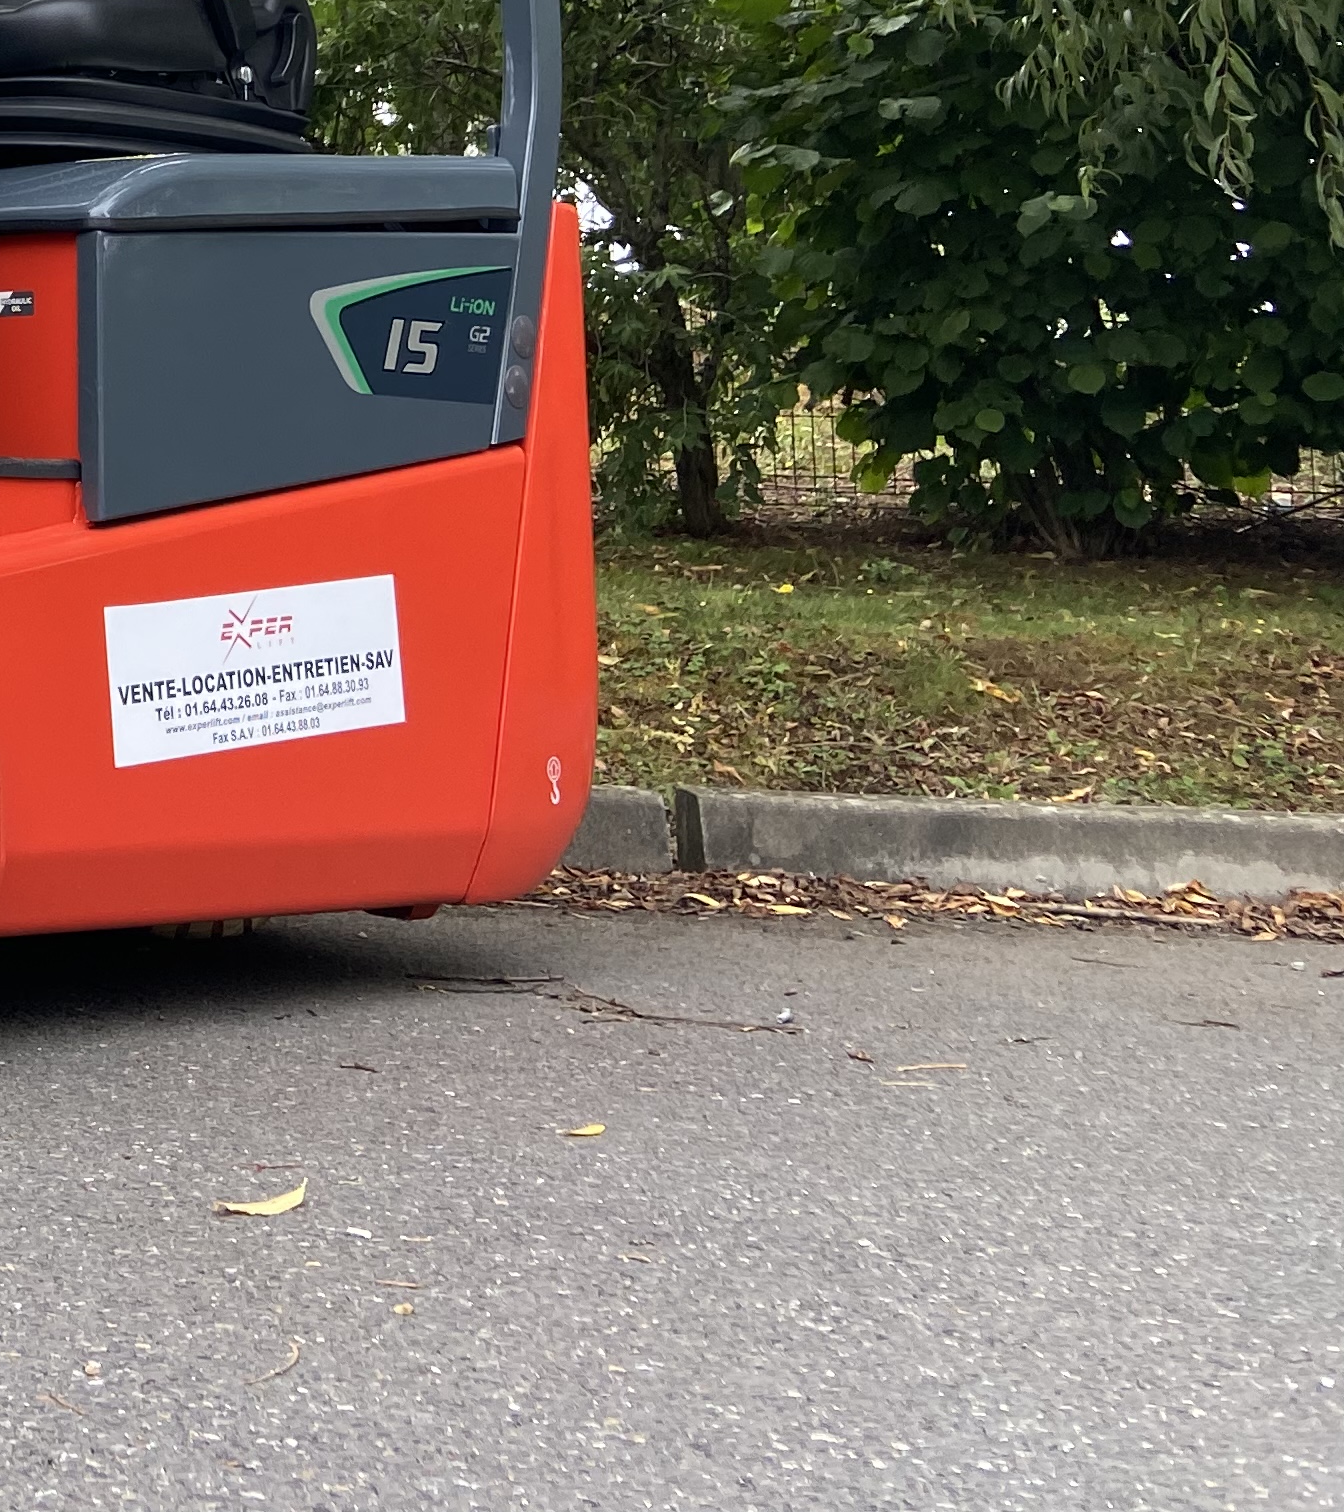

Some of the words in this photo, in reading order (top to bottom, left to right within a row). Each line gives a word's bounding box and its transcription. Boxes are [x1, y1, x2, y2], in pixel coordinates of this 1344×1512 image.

[383, 318, 443, 374] 15
[469, 325, 492, 343] G2
[117, 648, 394, 706] VENTE-LOCATION-ENTRETIEN-SAV
[155, 705, 174, 722] Tél
[184, 692, 269, 717] 01.64.43.26.08
[278, 689, 297, 703] Fax
[304, 677, 370, 699] 01.64.88.30.93
[212, 731, 229, 745] Fax
